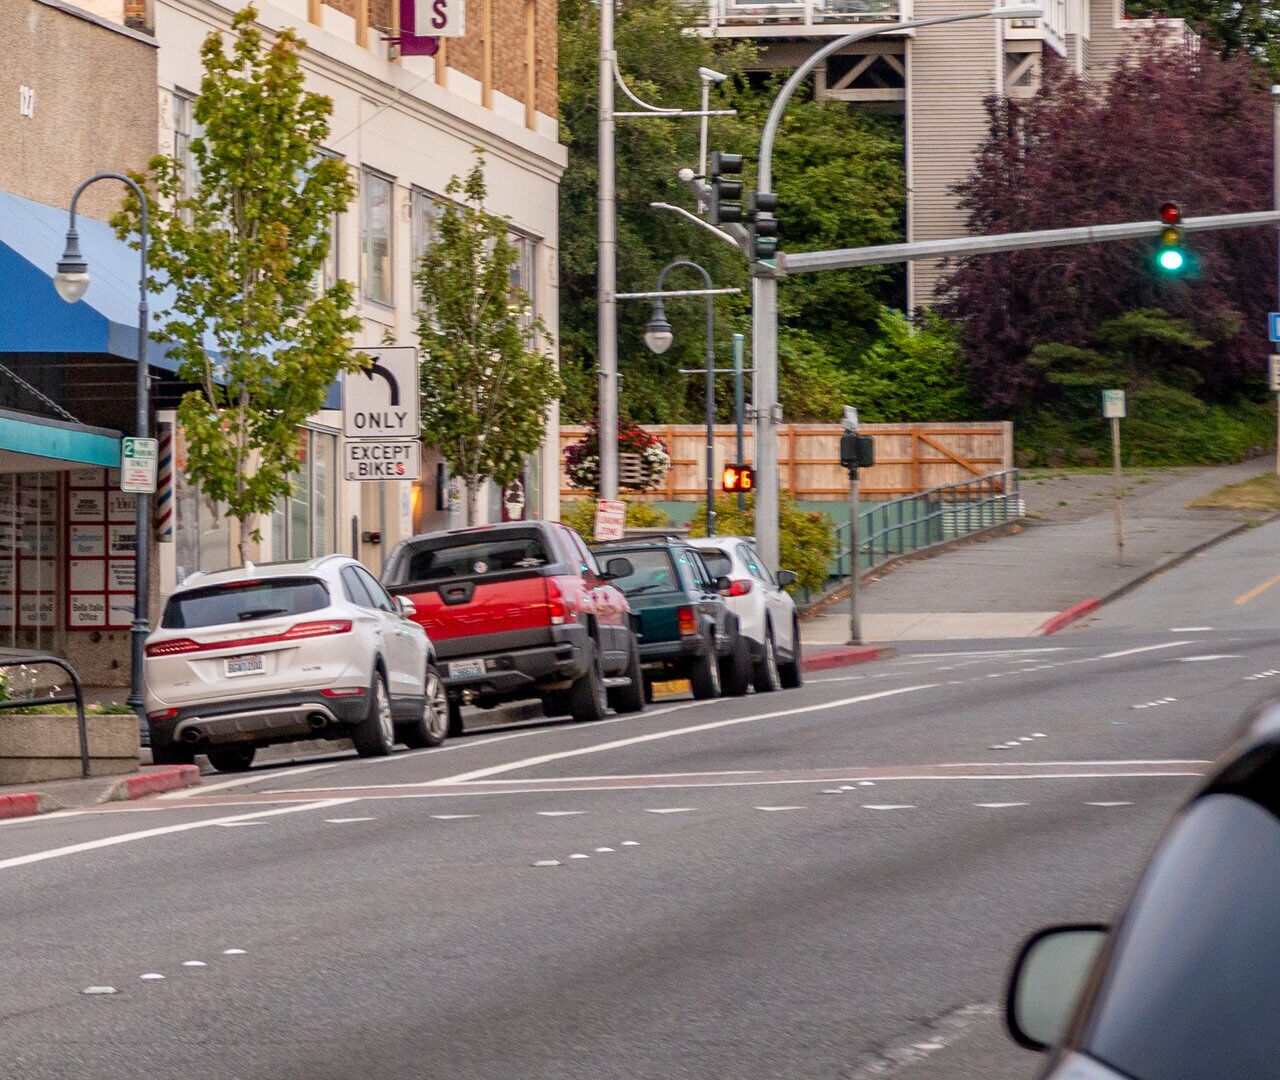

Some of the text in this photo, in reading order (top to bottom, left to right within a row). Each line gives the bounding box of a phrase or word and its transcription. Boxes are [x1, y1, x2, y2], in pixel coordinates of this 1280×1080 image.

[354, 412, 408, 429] ONLY
[351, 445, 412, 460] EXCEPT
[358, 461, 406, 476] BIKES
